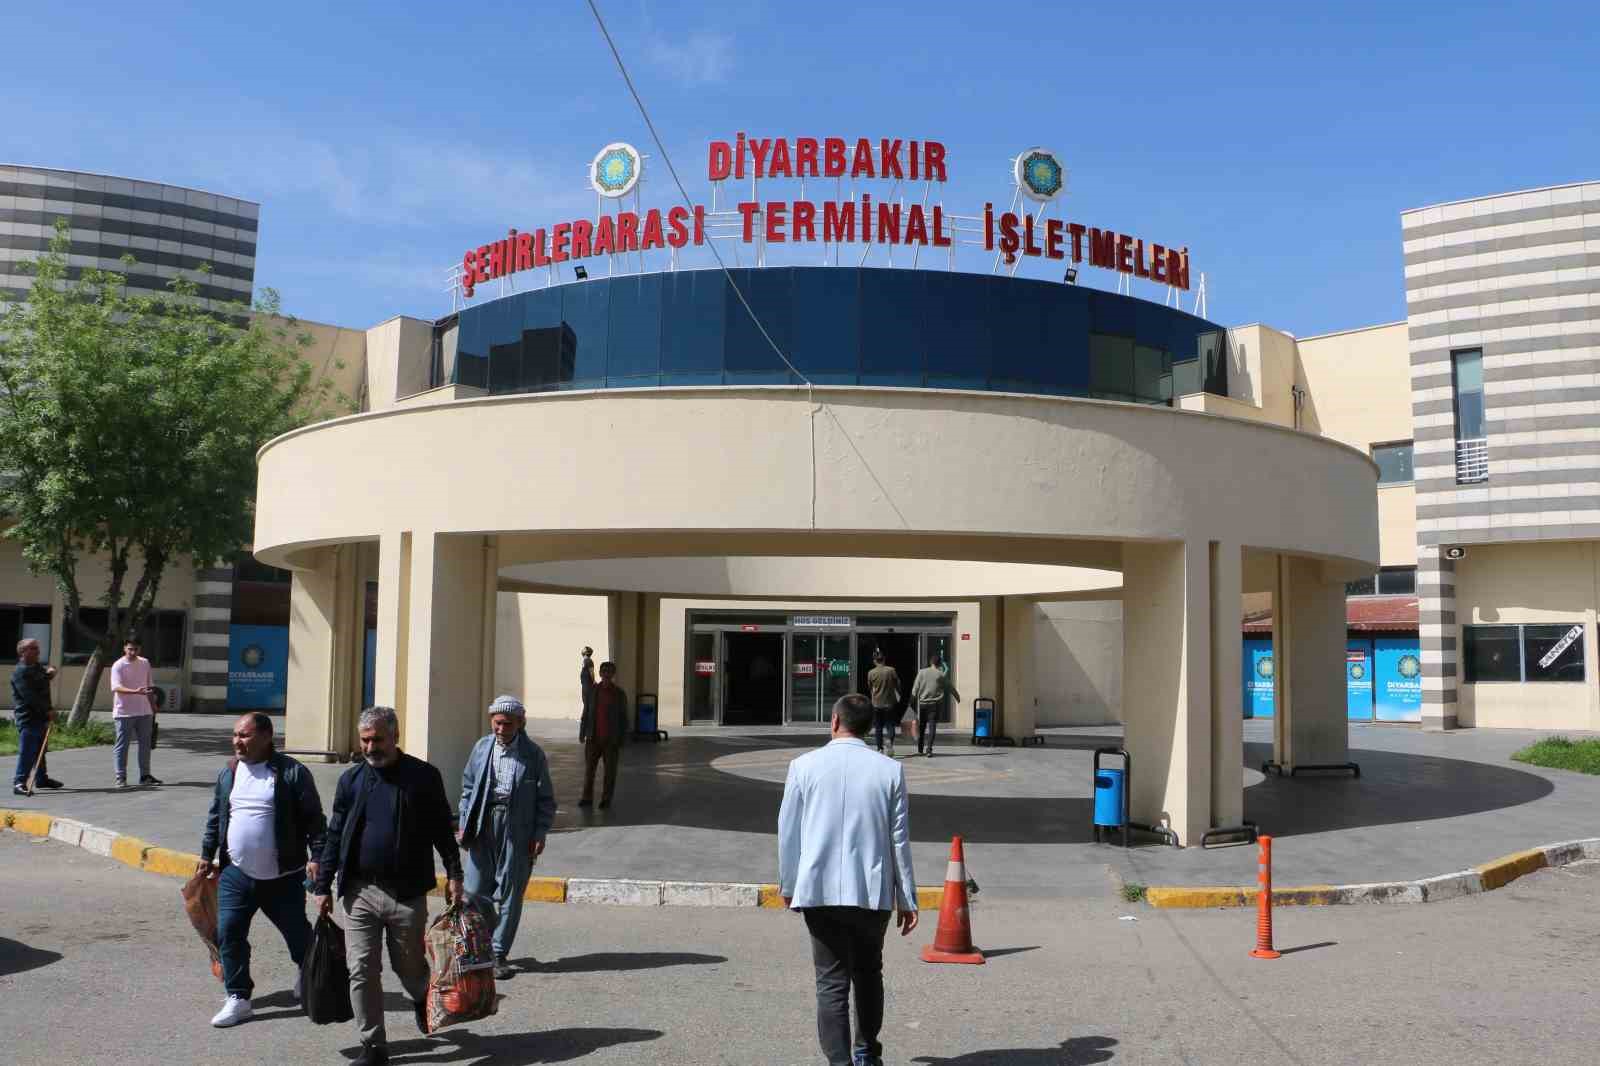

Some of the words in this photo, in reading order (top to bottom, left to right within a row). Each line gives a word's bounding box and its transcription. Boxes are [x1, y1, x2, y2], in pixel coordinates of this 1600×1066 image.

[709, 133, 946, 181] DİYARBAKIR
[463, 205, 705, 297] ŞEHİRLERARASI
[738, 193, 951, 247] TERMİNAL
[984, 202, 1189, 290] İŞLETMELERİ
